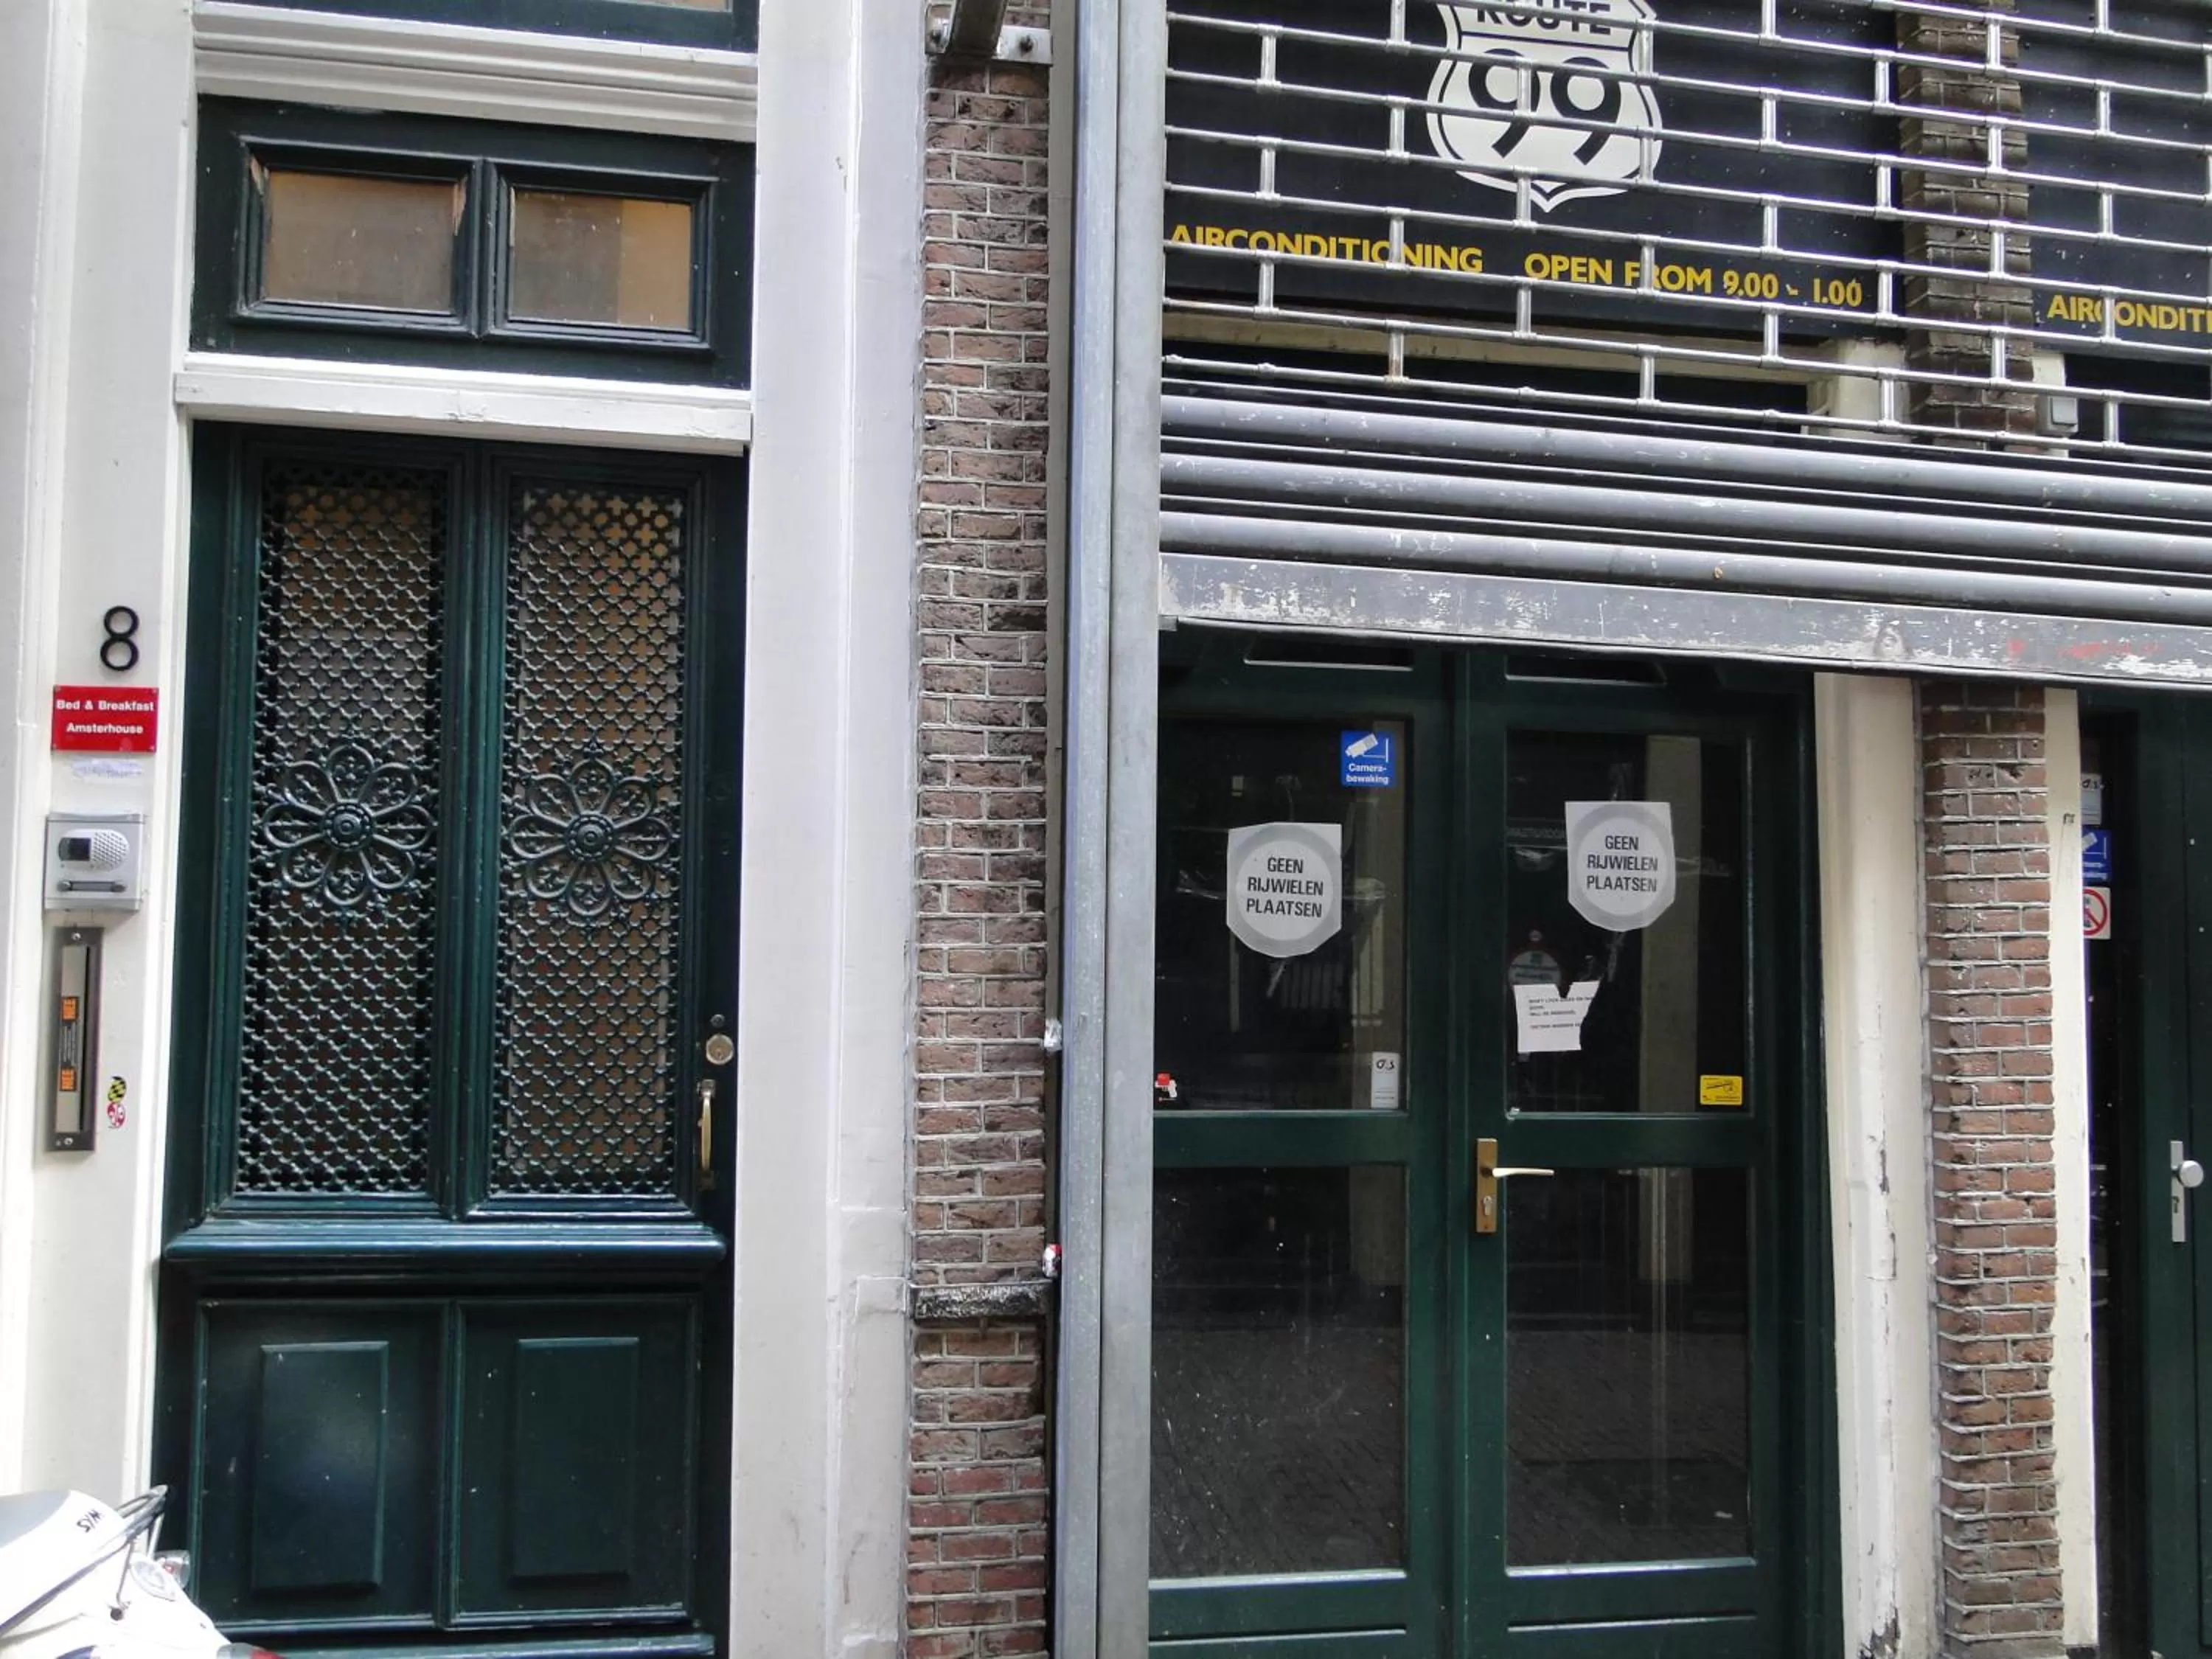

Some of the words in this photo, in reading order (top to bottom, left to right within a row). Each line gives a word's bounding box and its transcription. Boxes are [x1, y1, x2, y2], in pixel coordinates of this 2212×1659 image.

[1468, 48, 1621, 166] 99
[1170, 224, 1484, 273] AIRCONDITIONING
[1524, 253, 1613, 285] OPEN
[1723, 269, 1779, 299] 9.00
[100, 605, 140, 671] 8
[57, 699, 80, 710] Bed
[85, 700, 94, 711] &
[98, 700, 155, 712] Breakfast
[66, 723, 144, 734] Amsterhouse
[1346, 773, 1389, 785] bewaking
[1605, 835, 1638, 850] GEEN
[1267, 857, 1304, 874] GEEN
[1587, 854, 1658, 871] RIJWIELEN
[1248, 876, 1324, 896] RIJWIELEN
[1586, 874, 1657, 892] PLAATSEN
[1246, 897, 1323, 918] PLAATSEN
